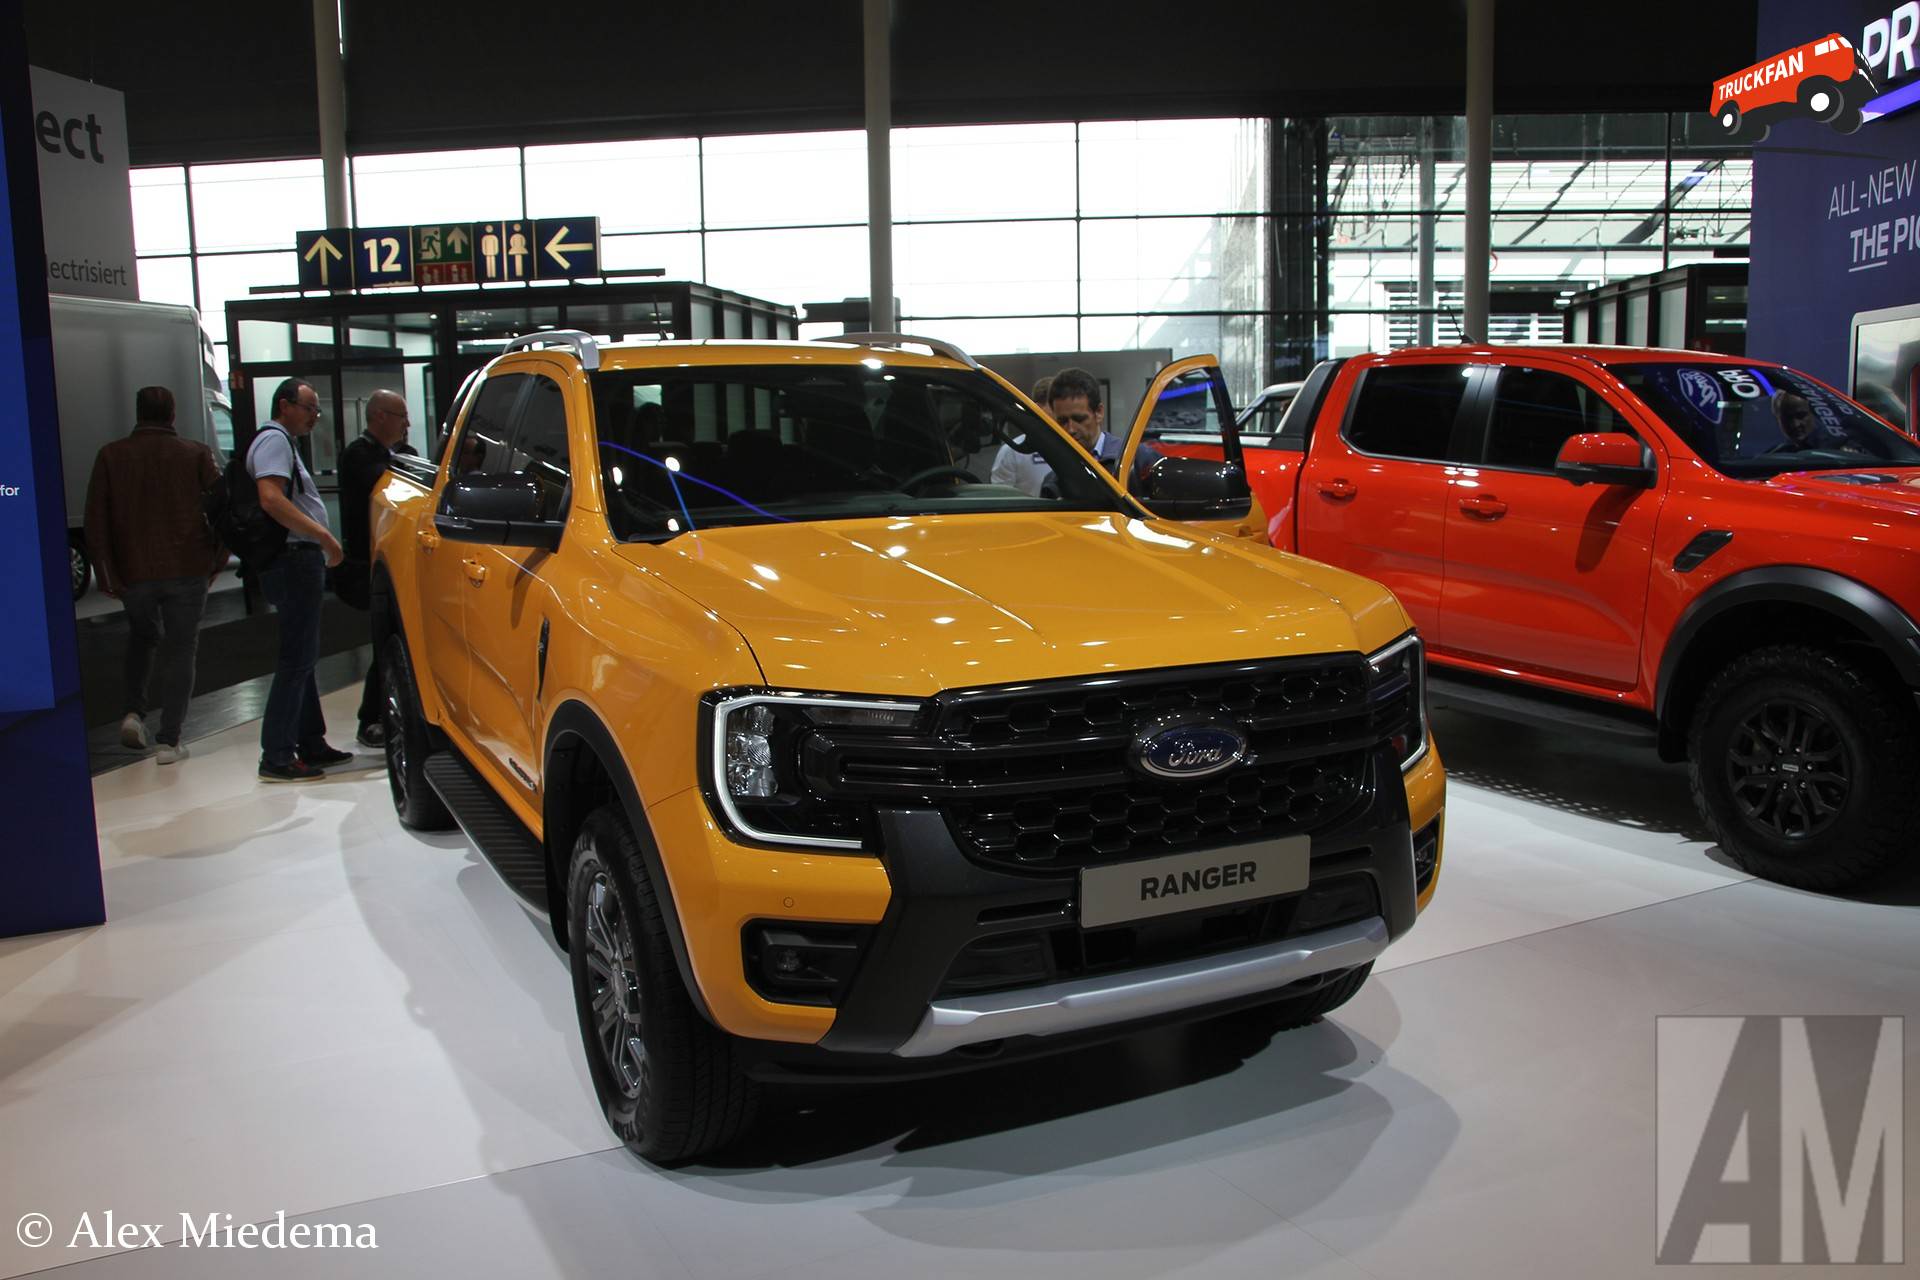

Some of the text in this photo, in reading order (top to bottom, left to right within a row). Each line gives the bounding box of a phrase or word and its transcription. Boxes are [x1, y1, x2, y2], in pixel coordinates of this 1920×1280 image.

[1862, 1, 1920, 80] PR
[35, 110, 104, 165] ect
[1828, 159, 1917, 220] ALL-NEW
[364, 237, 402, 273] 12
[1850, 221, 1890, 263] THE
[0, 484, 20, 496] for
[1168, 738, 1224, 767] Ford
[1140, 860, 1257, 901] RANGER
